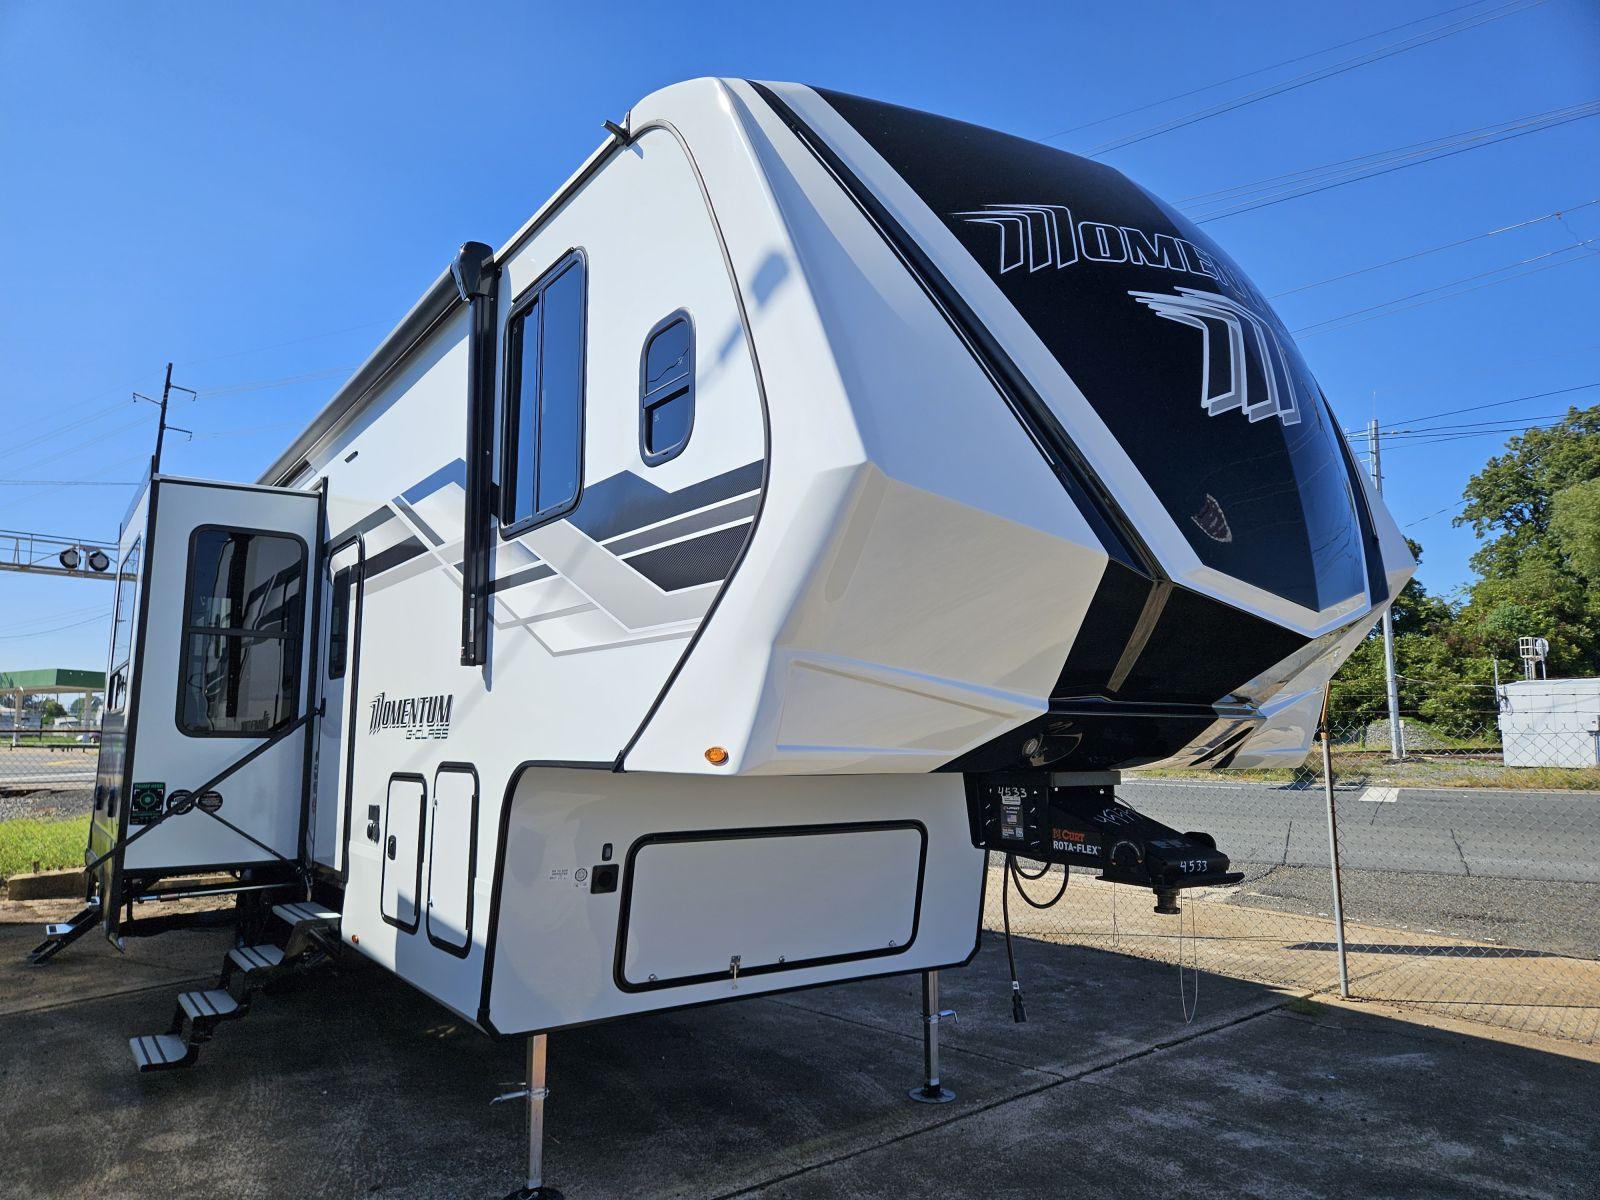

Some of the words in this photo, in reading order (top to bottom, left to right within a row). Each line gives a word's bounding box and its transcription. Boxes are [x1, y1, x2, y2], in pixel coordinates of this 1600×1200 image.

[369, 691, 453, 735] MOMENTUM
[998, 786, 1027, 798] 4533
[1061, 829, 1086, 843] CURT
[1180, 860, 1208, 872] 4533
